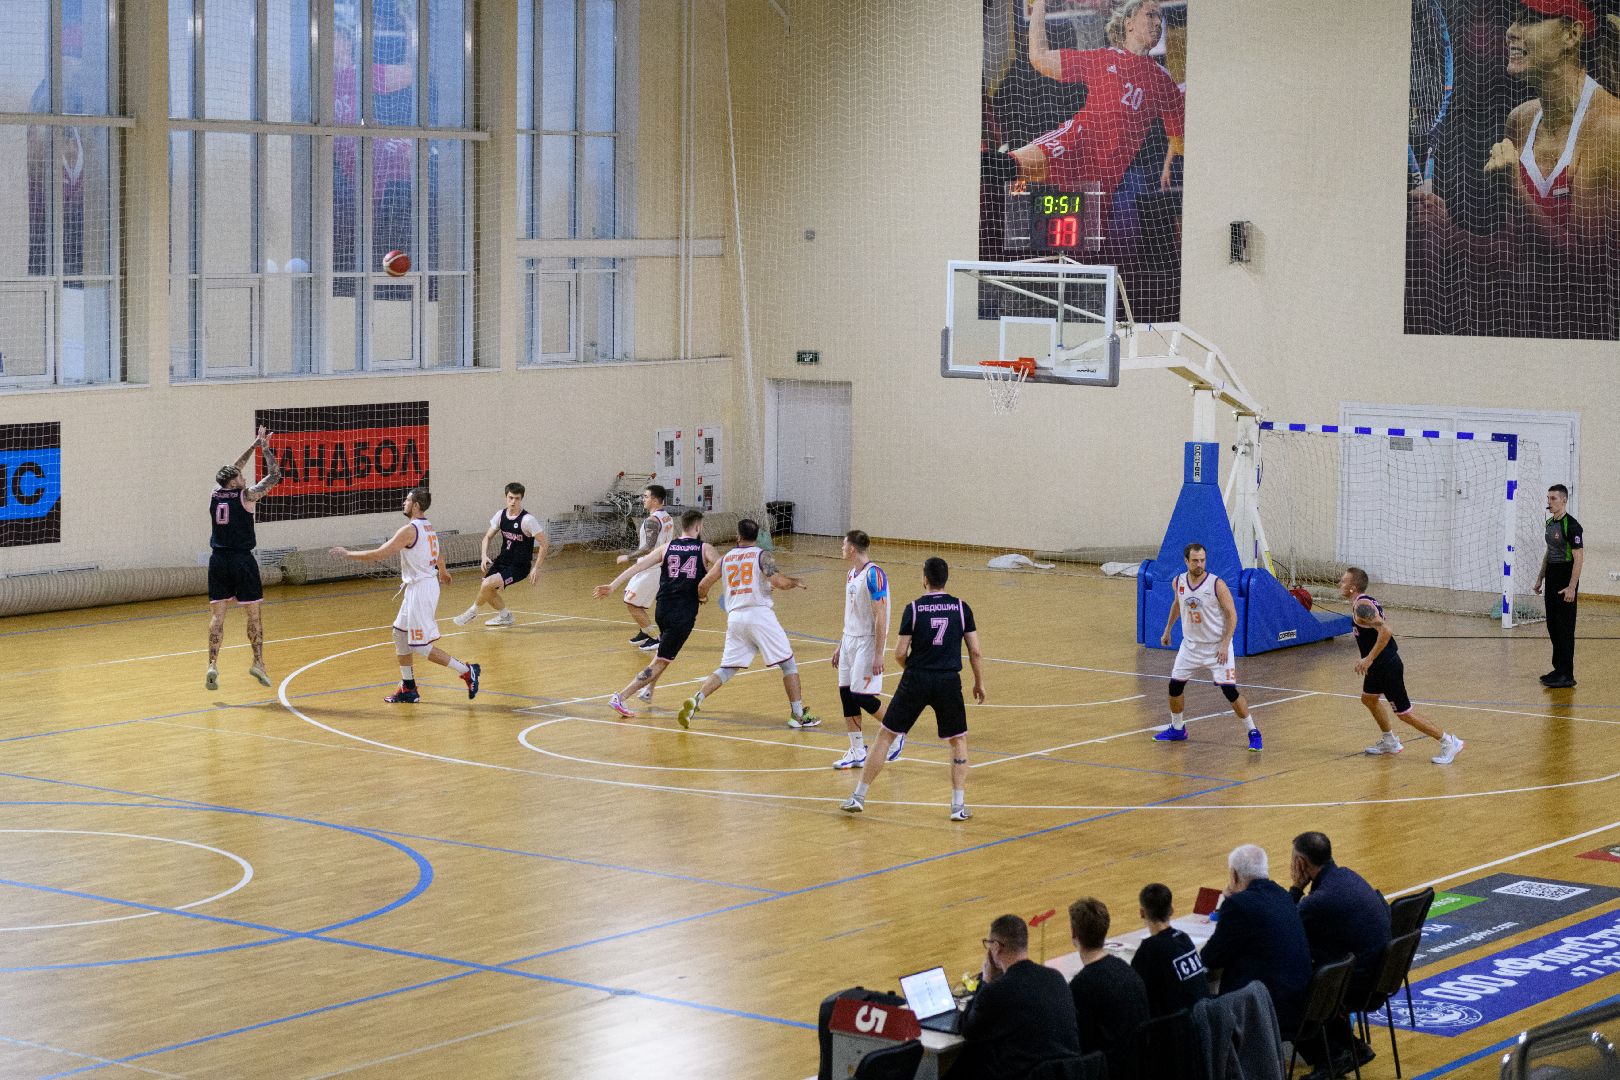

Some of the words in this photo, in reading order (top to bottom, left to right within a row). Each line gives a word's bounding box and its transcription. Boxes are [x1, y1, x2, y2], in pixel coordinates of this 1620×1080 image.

[1121, 82, 1144, 111] 20
[1044, 195, 1080, 214] 9:51
[1053, 216, 1078, 247] 17
[215, 502, 230, 525] 0
[667, 554, 698, 579] 84
[726, 562, 754, 588] 28
[917, 603, 960, 612] ФЕДЮШИН
[1186, 611, 1202, 624] 13
[410, 629, 425, 641] 15
[930, 617, 949, 646] 7
[863, 675, 872, 690] 7
[855, 1004, 888, 1034] 5
